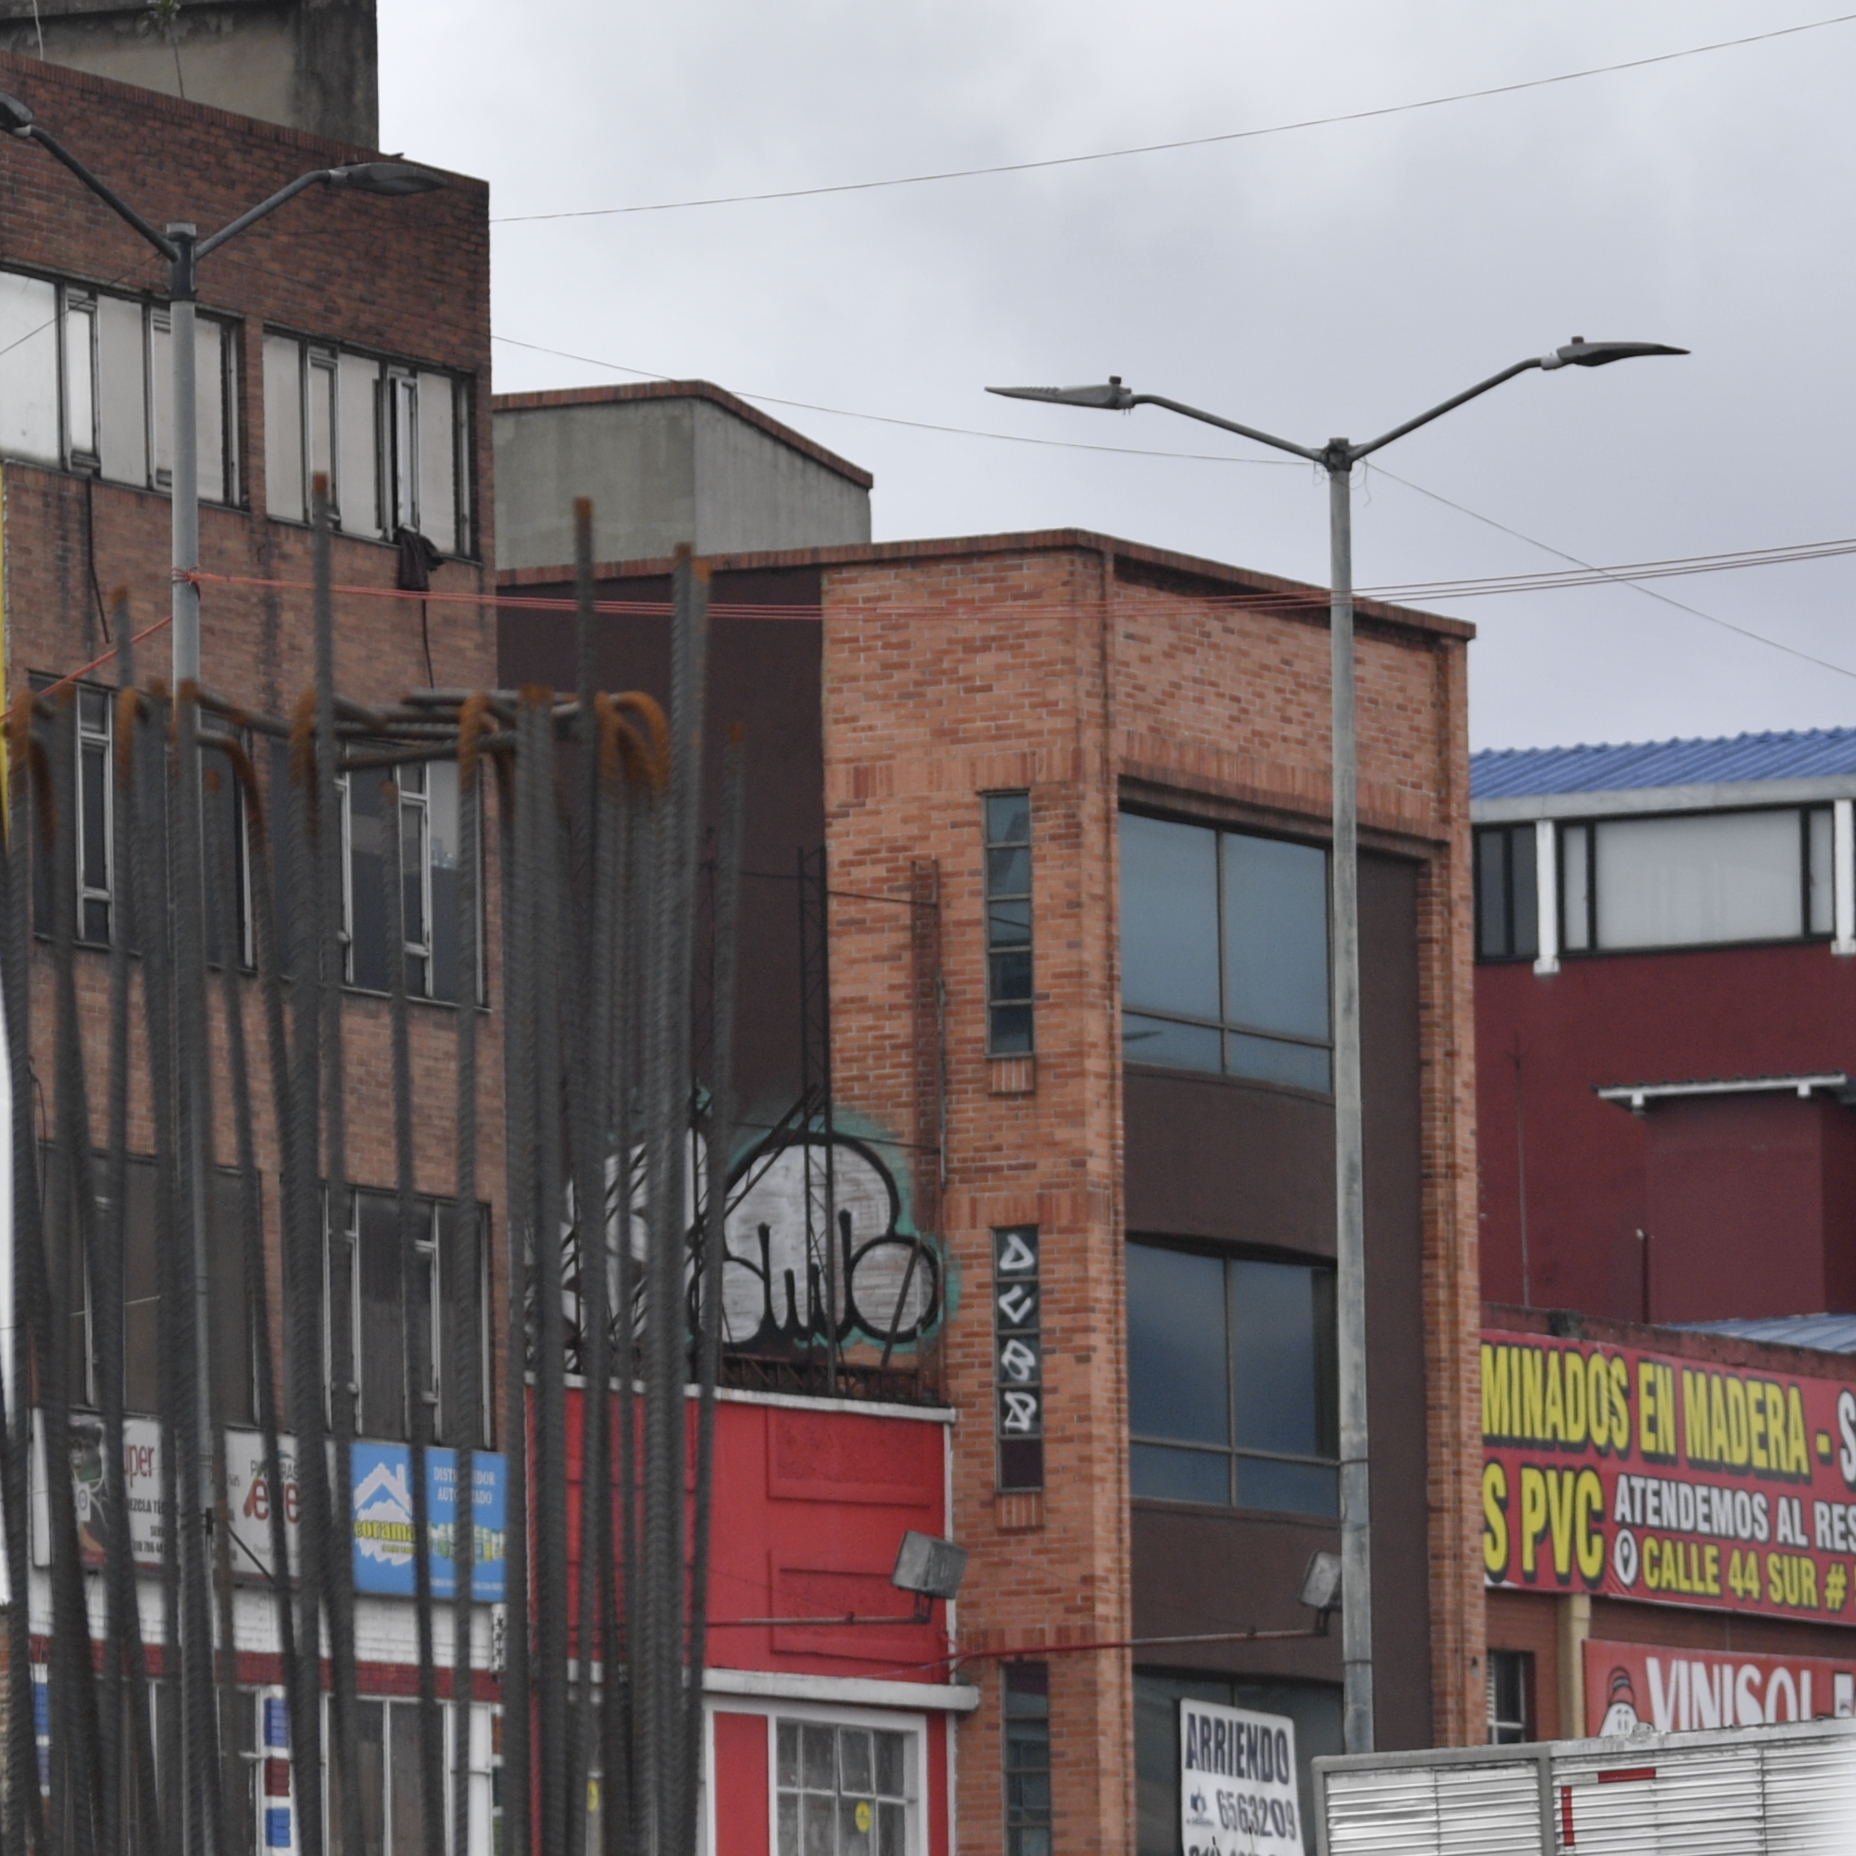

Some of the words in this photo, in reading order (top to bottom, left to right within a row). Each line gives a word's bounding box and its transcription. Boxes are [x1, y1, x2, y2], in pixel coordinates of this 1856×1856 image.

[1639, 1362, 1676, 1455] EN
[1683, 1370, 1810, 1476] MADERA
[1521, 1466, 1604, 1580] PVC
[1614, 1474, 1770, 1541] ATENDEMOS
[1777, 1497, 1809, 1547] AL
[1643, 1536, 1722, 1597] CALLE
[1729, 1550, 1761, 1601] 44
[1767, 1553, 1819, 1608] SUR
[1185, 1711, 1290, 1786] ARRIENDO
[1216, 1788, 1298, 1841] 6563209
